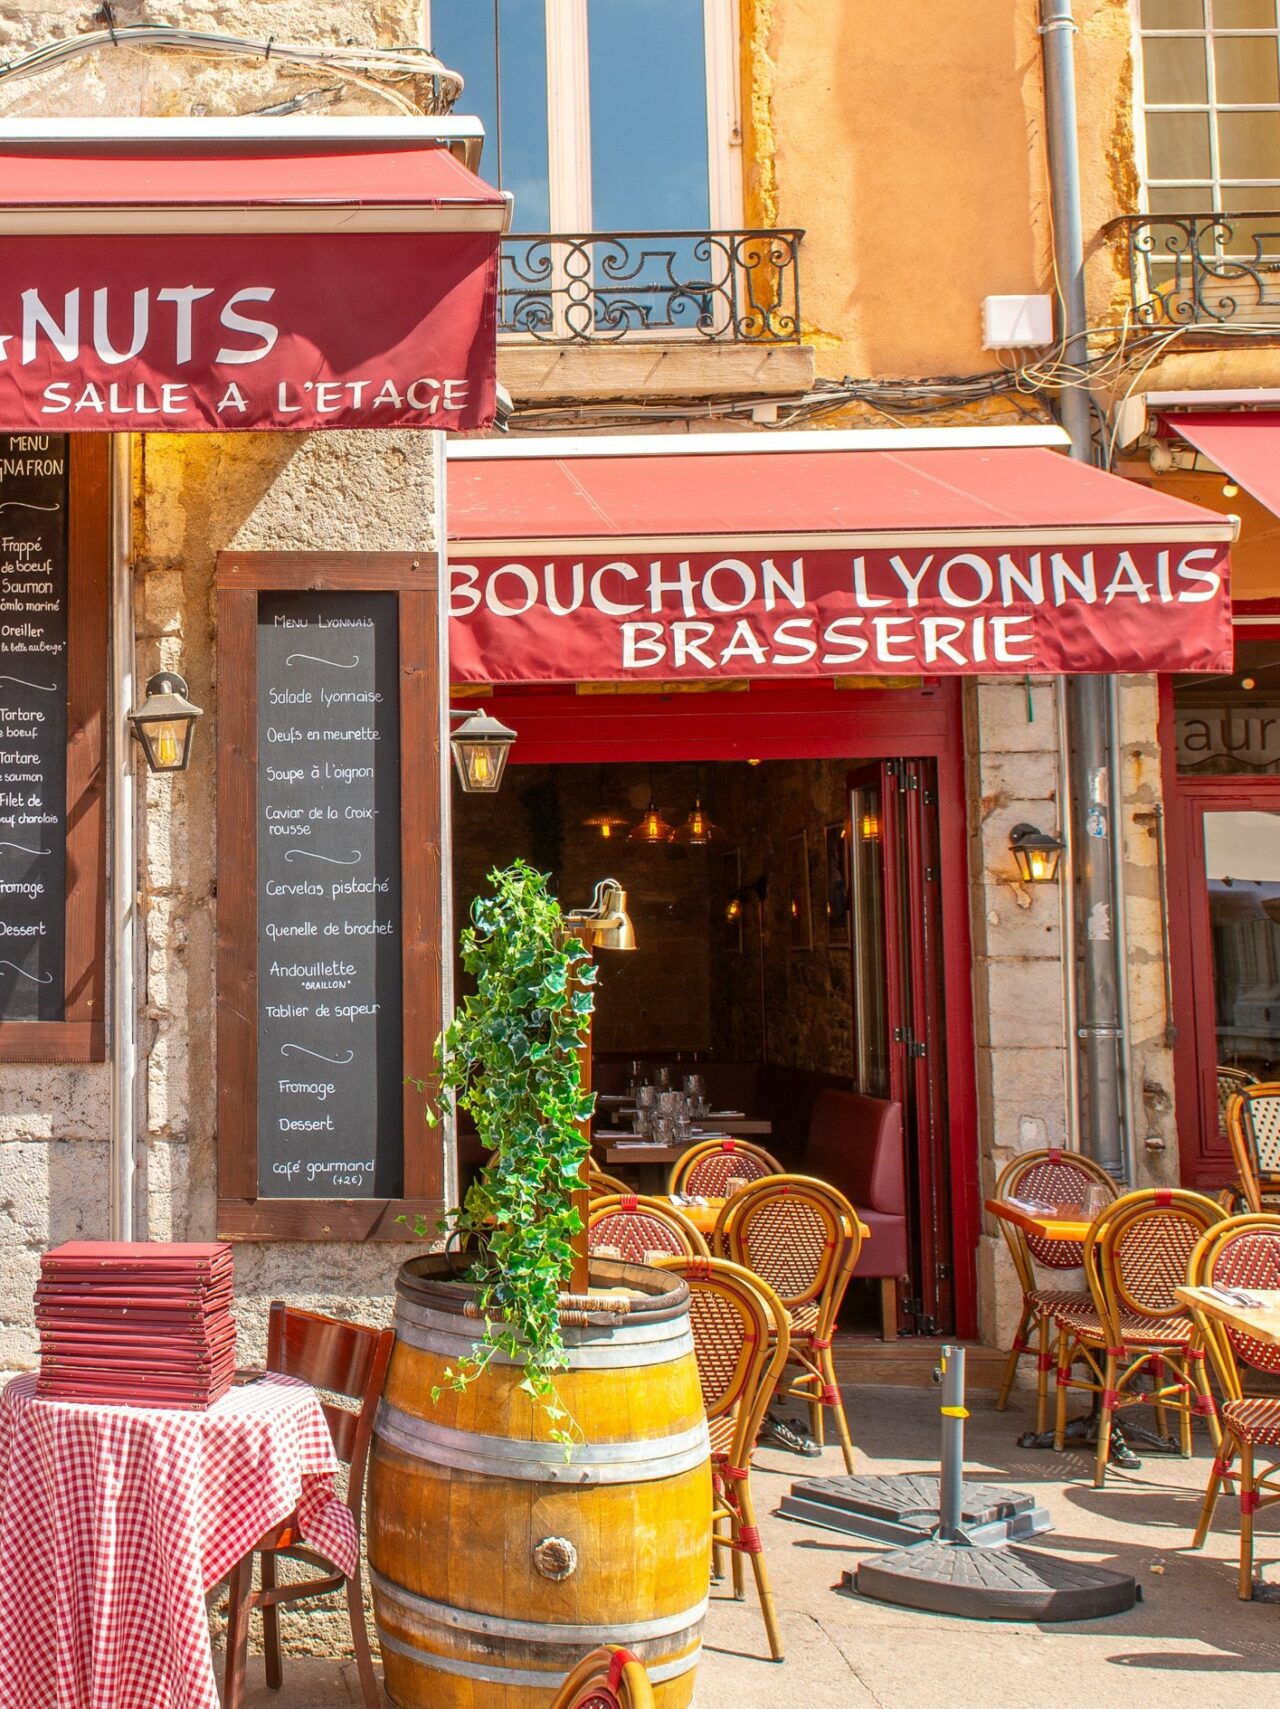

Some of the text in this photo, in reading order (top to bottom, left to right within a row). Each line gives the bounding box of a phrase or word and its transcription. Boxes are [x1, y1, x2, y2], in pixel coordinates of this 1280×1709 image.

[41, 378, 470, 414] SALLE A L'ETAGE
[10, 435, 49, 451] MENU
[1, 536, 43, 561] Frappé
[0, 559, 53, 575] de boeuf
[1, 578, 53, 594] Saumon
[448, 549, 1222, 617] BOUCHON LYONNAIS
[26, 599, 60, 611] mariné
[1, 623, 44, 637] Oreiller
[622, 616, 1035, 669] BRASSERIE
[269, 688, 384, 708] Salade lyonnaise
[0, 707, 45, 722] Tartare
[6, 726, 38, 739] boeuf
[267, 726, 381, 744] Oeufs en meurette
[1175, 719, 1277, 751] aur
[0, 751, 41, 764] Tartare
[4, 773, 43, 782] saumon
[267, 762, 374, 784] Soupe à l'oignon
[27, 793, 43, 807] de
[18, 812, 58, 824] charolais
[266, 805, 304, 820] Caviar
[308, 807, 323, 820] de
[327, 806, 338, 819] la
[269, 824, 311, 836] rousse
[266, 876, 390, 900] Cervelas pistaché
[266, 920, 394, 942] Quenelle de brochet
[269, 961, 357, 977] Andouillette
[265, 1003, 381, 1022] Tablier de sapeur
[278, 1080, 336, 1101] Fromage
[278, 1115, 334, 1131] Dessert
[307, 1159, 375, 1181] gourmand
[332, 1174, 362, 1187] (+2€)
